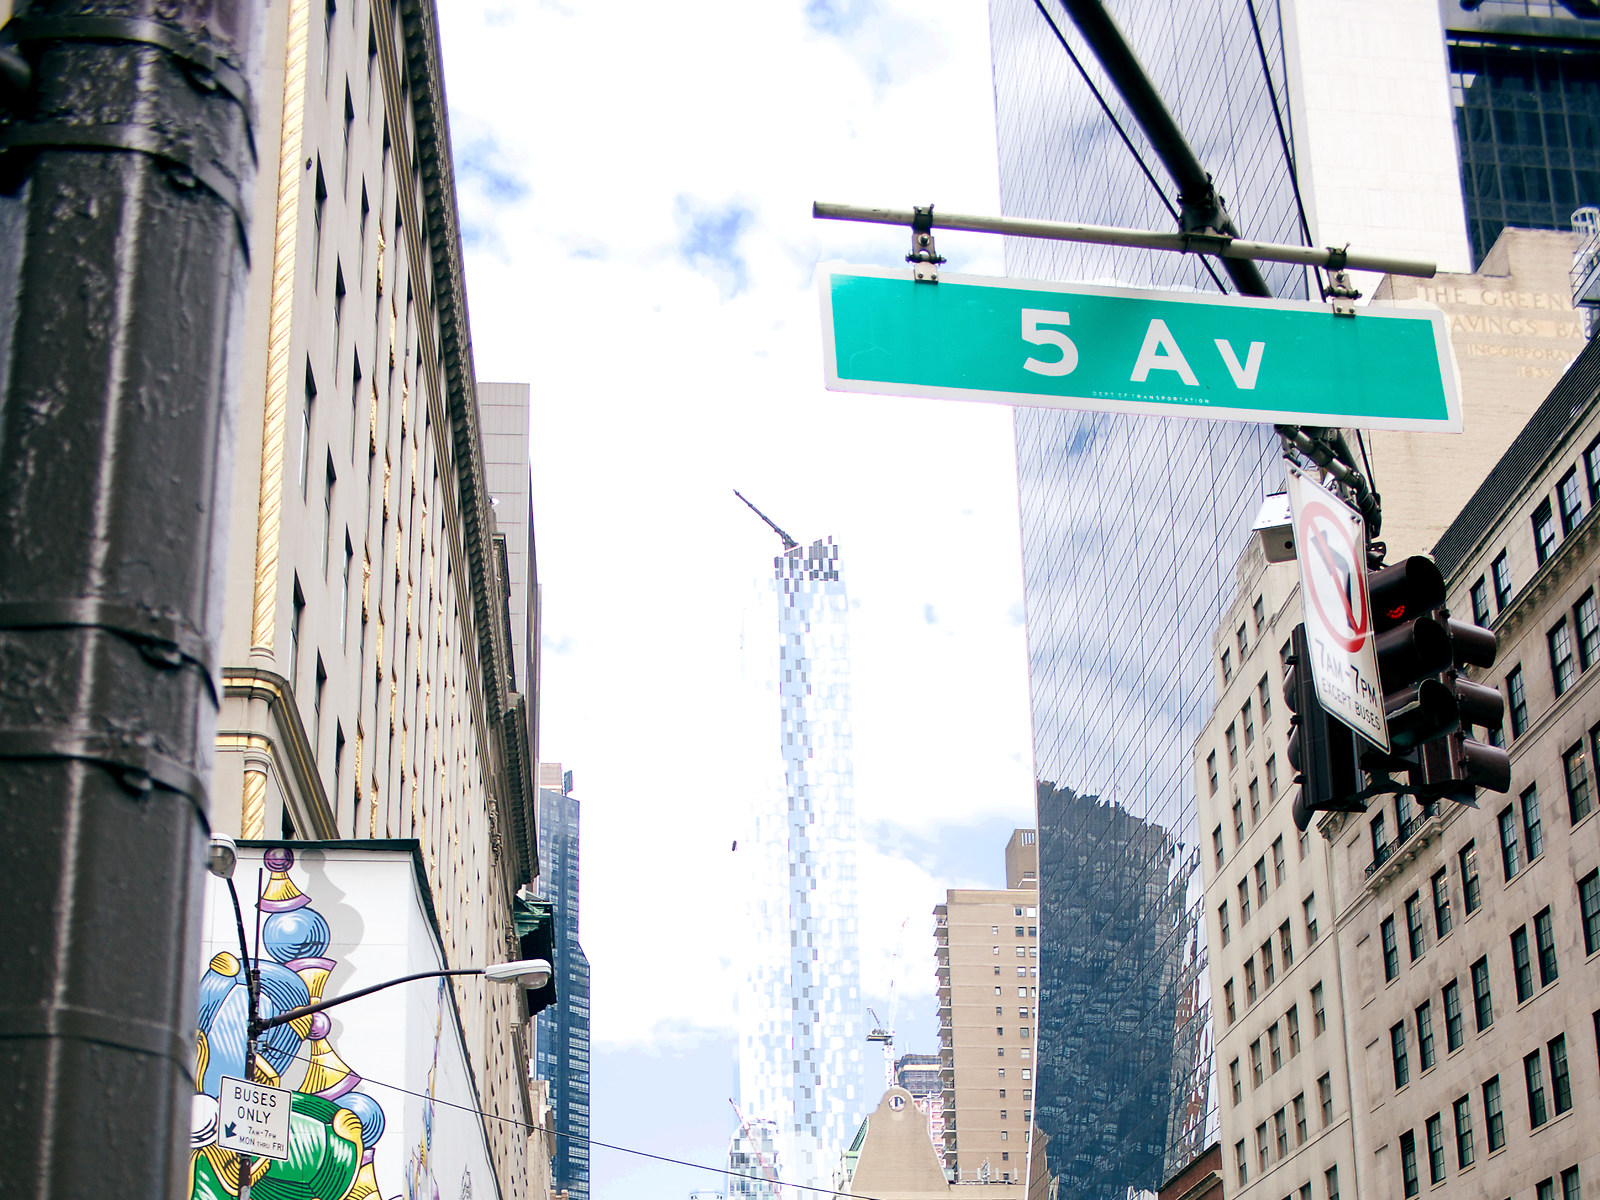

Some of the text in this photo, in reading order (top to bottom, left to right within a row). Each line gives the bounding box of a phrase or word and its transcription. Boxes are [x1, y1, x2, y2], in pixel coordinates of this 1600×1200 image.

[1417, 285, 1467, 304] THE
[1451, 314, 1584, 339] AVINGS BA
[1021, 308, 1079, 377] 5
[1467, 343, 1576, 362] INCORPORAT
[1321, 677, 1381, 731] EXCEPT BUSES
[234, 1086, 277, 1108] BUSES
[237, 1105, 271, 1125] ONLY
[239, 1135, 284, 1152] MON THRU FRI
